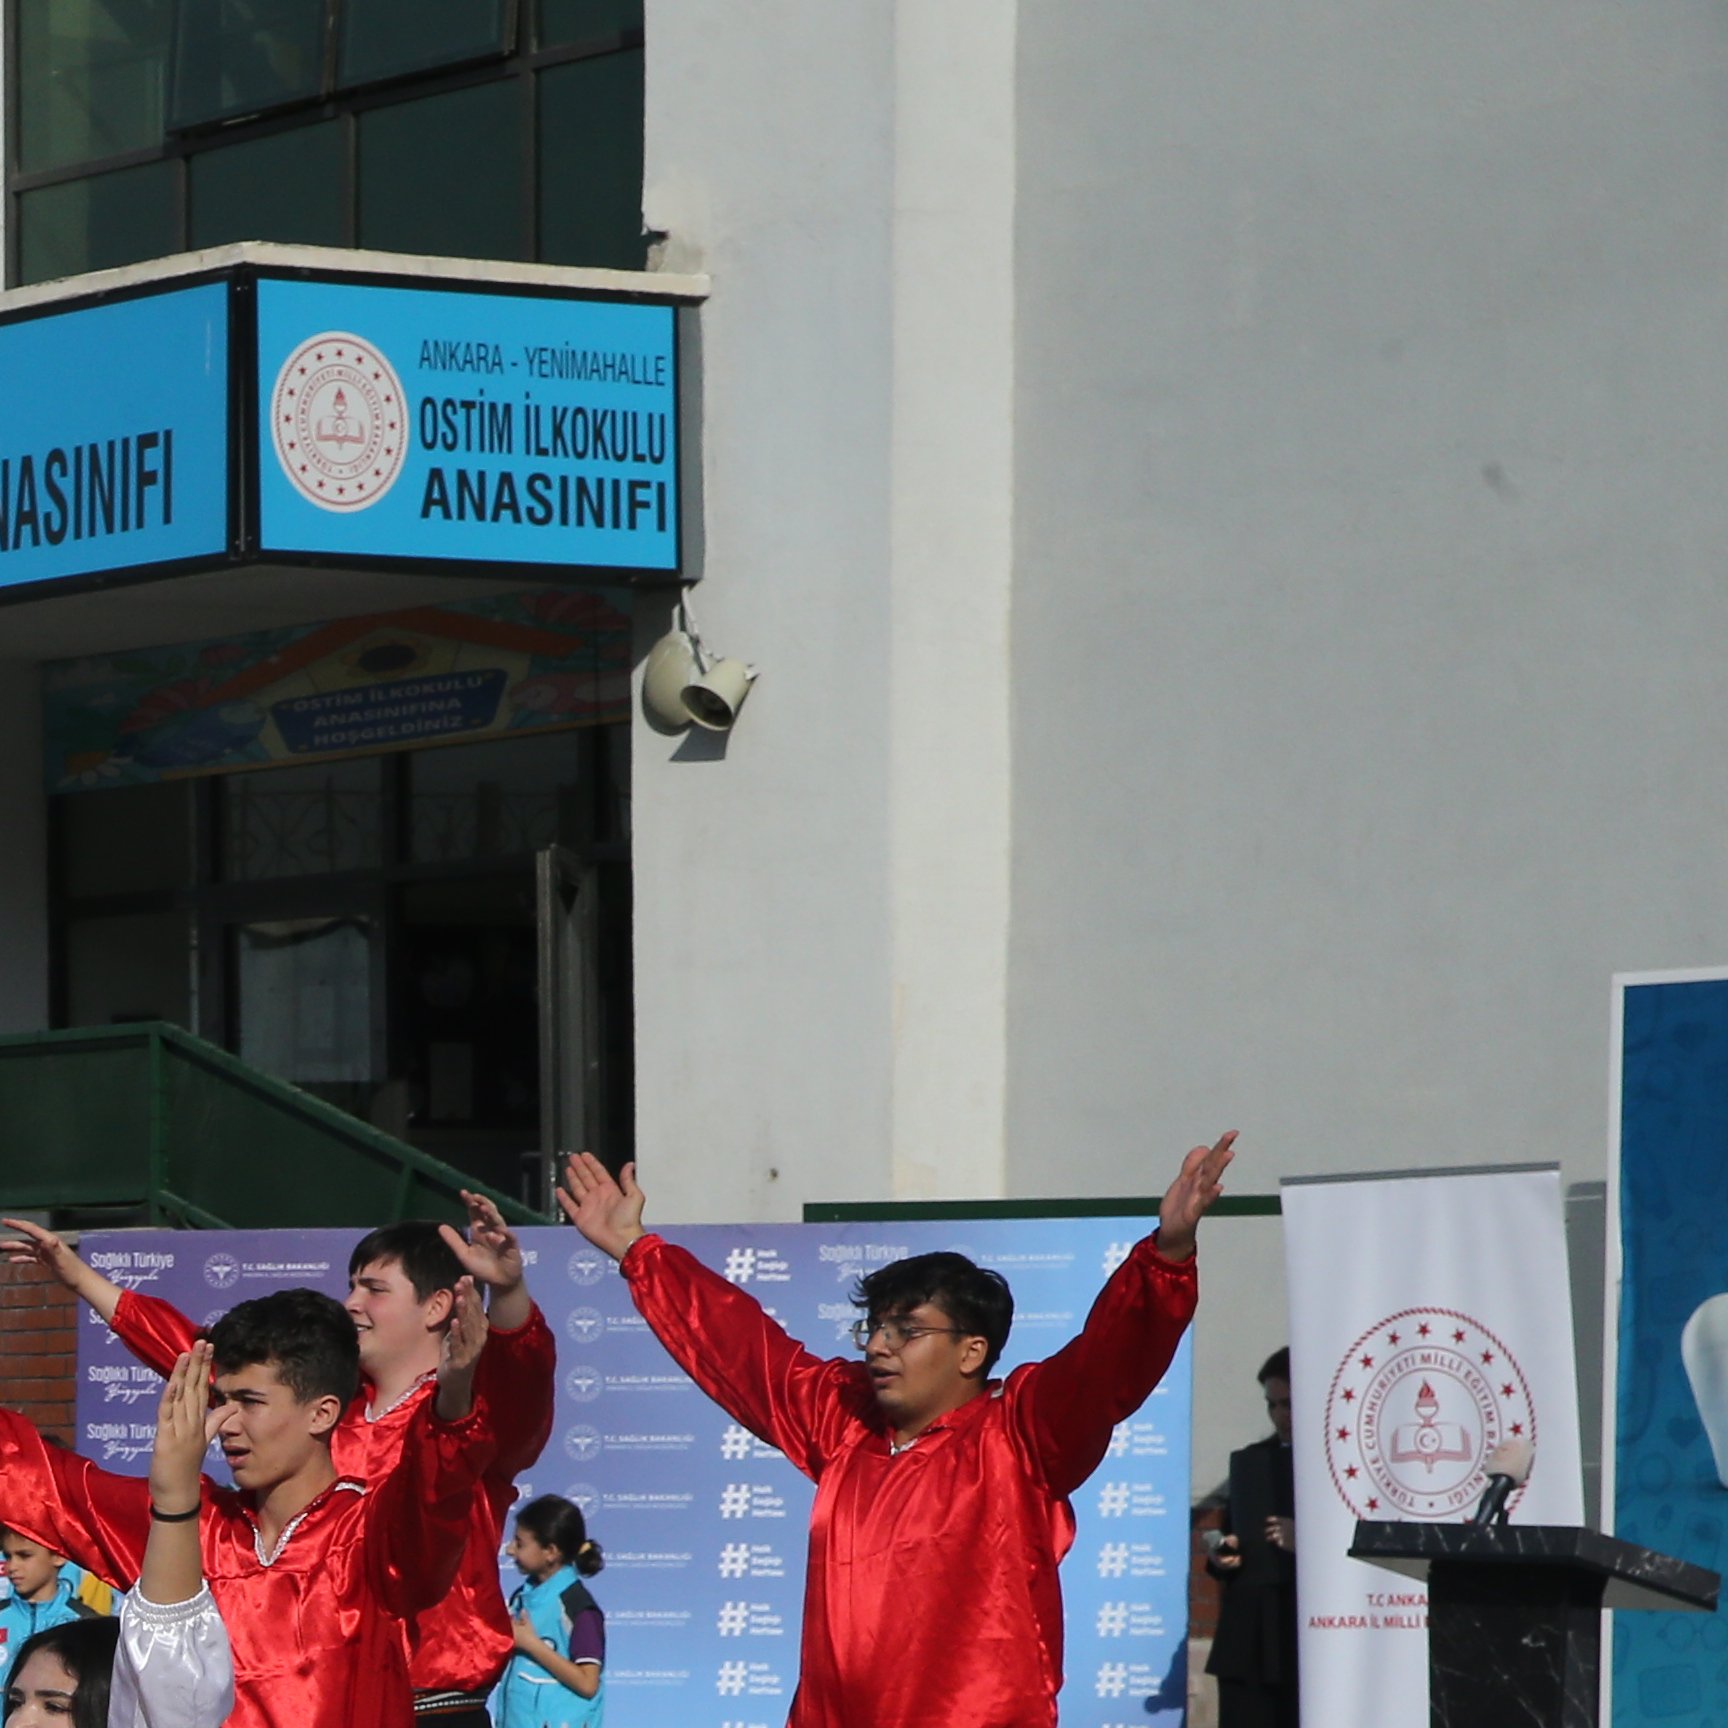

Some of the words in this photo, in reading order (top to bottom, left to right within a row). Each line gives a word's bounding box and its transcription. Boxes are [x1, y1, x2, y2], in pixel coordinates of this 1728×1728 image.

[419, 339, 504, 375] ANKARA
[523, 341, 666, 386] YENİMAHALLE
[419, 389, 512, 454] OSTİM
[523, 391, 665, 464] İLKOKULU
[420, 466, 666, 533] ANASINIFI
[293, 688, 363, 712] OSTİM
[369, 676, 482, 701] İLKOKULU
[312, 697, 463, 729] ANASINIFINA
[1308, 1615, 1367, 1629] ANKARA
